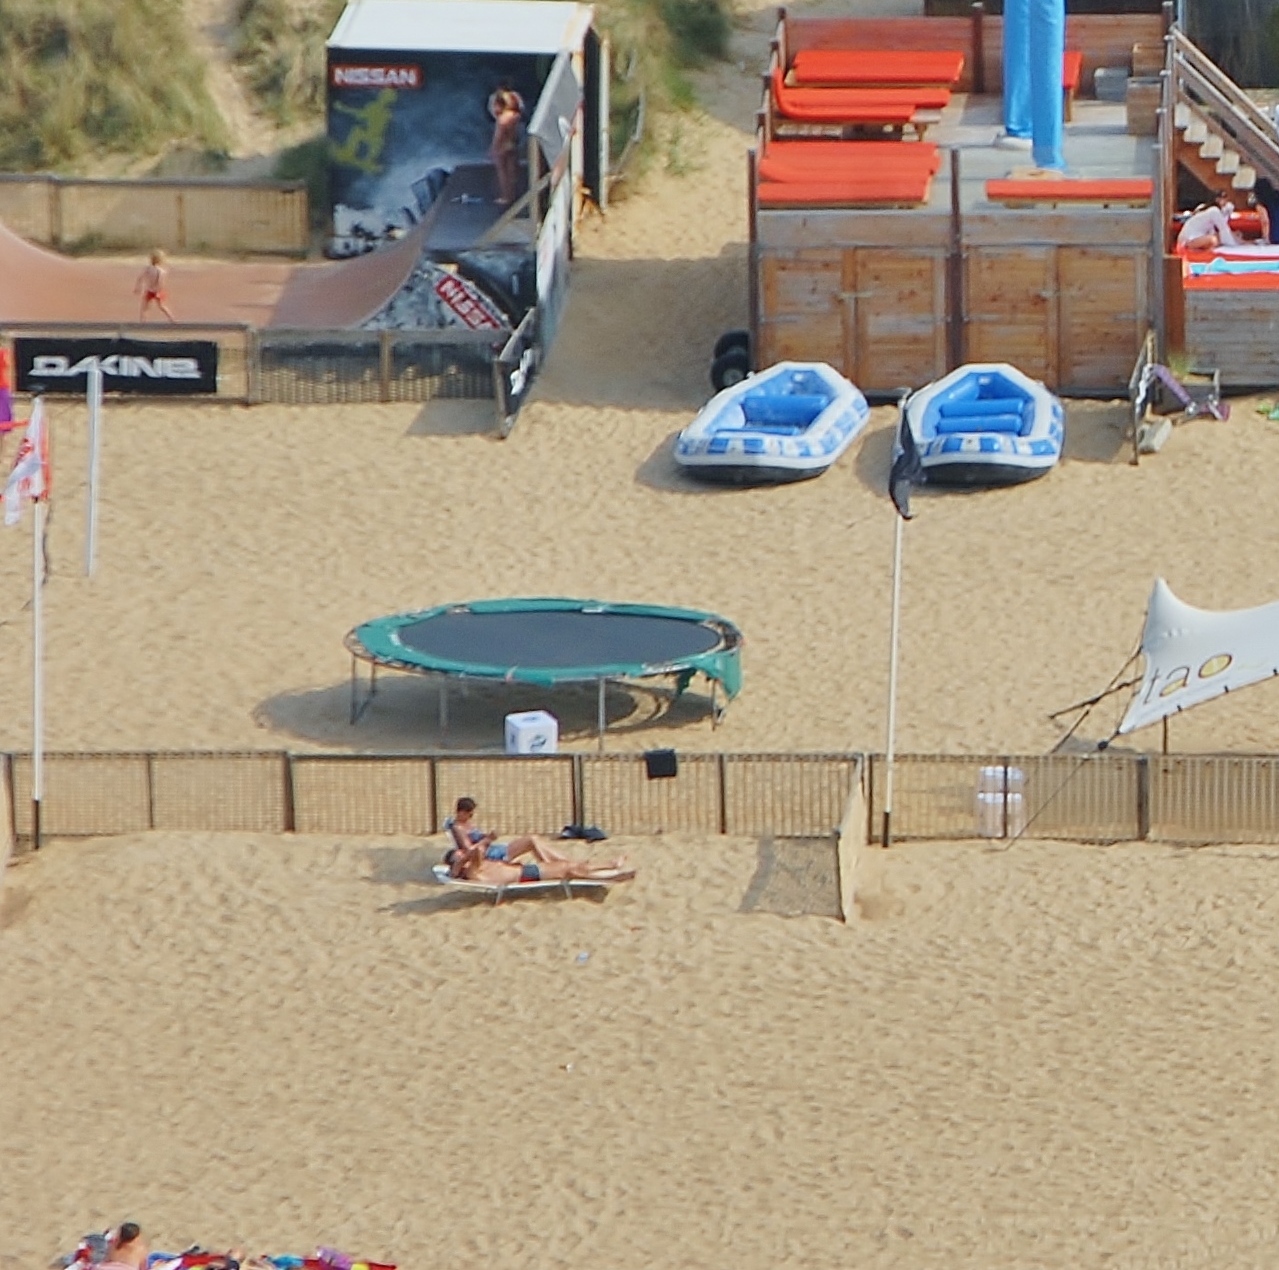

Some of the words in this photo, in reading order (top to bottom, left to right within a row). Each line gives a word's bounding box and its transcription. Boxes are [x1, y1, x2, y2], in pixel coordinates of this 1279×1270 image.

[334, 66, 417, 86] NISSAN
[28, 354, 203, 379] DAKINE
[1143, 653, 1233, 705] tao
